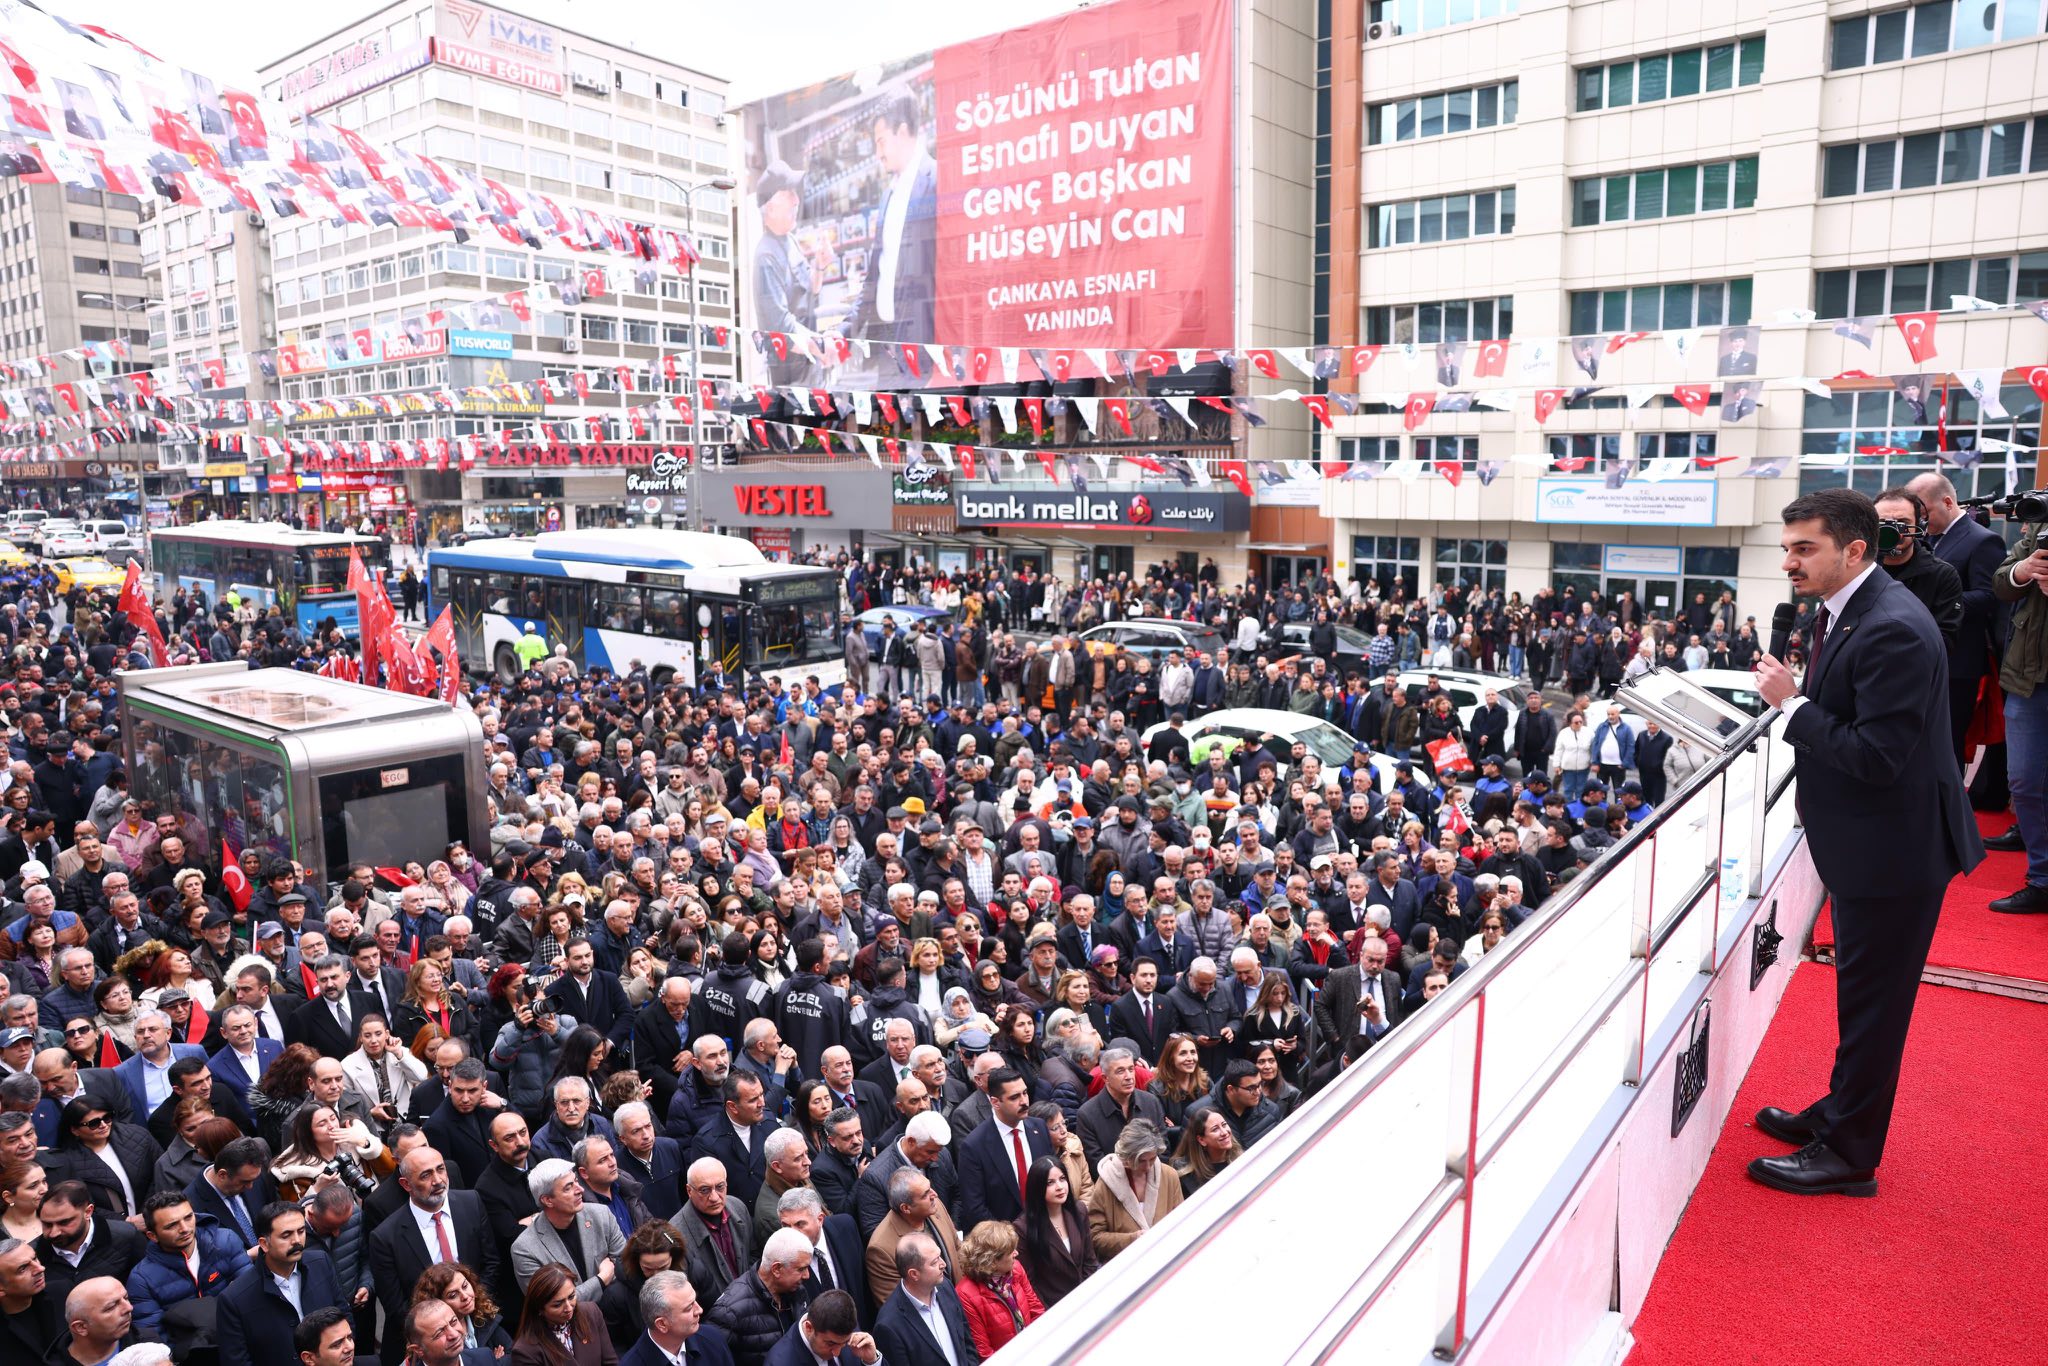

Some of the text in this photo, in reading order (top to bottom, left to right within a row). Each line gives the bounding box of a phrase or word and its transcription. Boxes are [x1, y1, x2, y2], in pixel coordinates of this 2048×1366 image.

[489, 13, 553, 54] İVME
[446, 40, 558, 90] İVME EĞİTİM
[987, 269, 1156, 309] ÇANKAYA ESNAFI
[1024, 306, 1113, 332] YANINDA
[454, 336, 511, 351] TUSWORLD
[497, 402, 542, 413] KURUMU
[487, 445, 572, 465] ZAFER
[733, 485, 832, 516] VESTEL
[962, 494, 1119, 521] bank mellat
[1550, 495, 1575, 507] SGK
[1161, 507, 1187, 518] ملت
[705, 986, 736, 1009] ÖZEL
[787, 990, 823, 1010] ÖZEL
